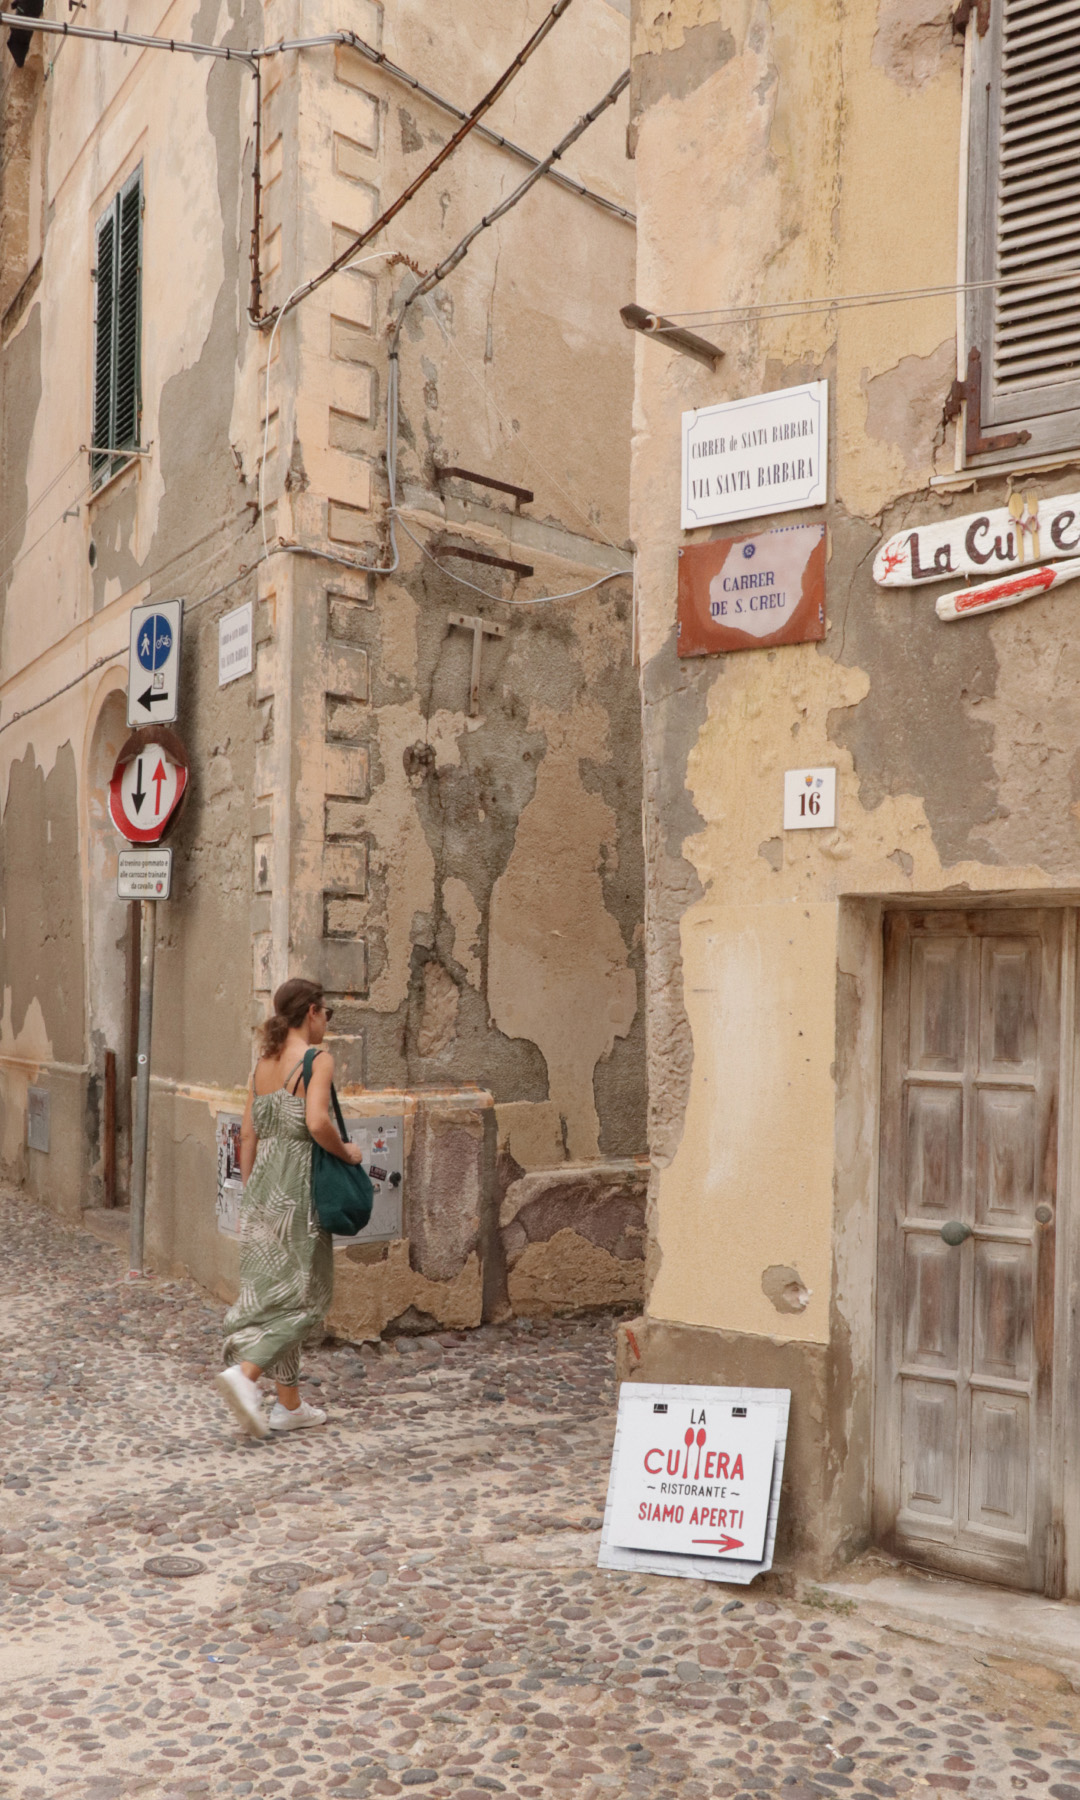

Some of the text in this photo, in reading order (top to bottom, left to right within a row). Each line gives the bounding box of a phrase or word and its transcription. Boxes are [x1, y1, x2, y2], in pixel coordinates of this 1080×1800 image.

[692, 418, 814, 459] CARRER de SANTA BARBARA
[692, 456, 813, 500] VIA SANTA BARBARA
[902, 532, 960, 579] La
[722, 571, 775, 592] CARRER
[711, 592, 786, 616] DE S. CREU
[799, 791, 821, 816] 16
[690, 1408, 706, 1425] LA
[660, 1482, 727, 1498] RISTORANTE
[638, 1502, 744, 1529] SIAMO APERTI
